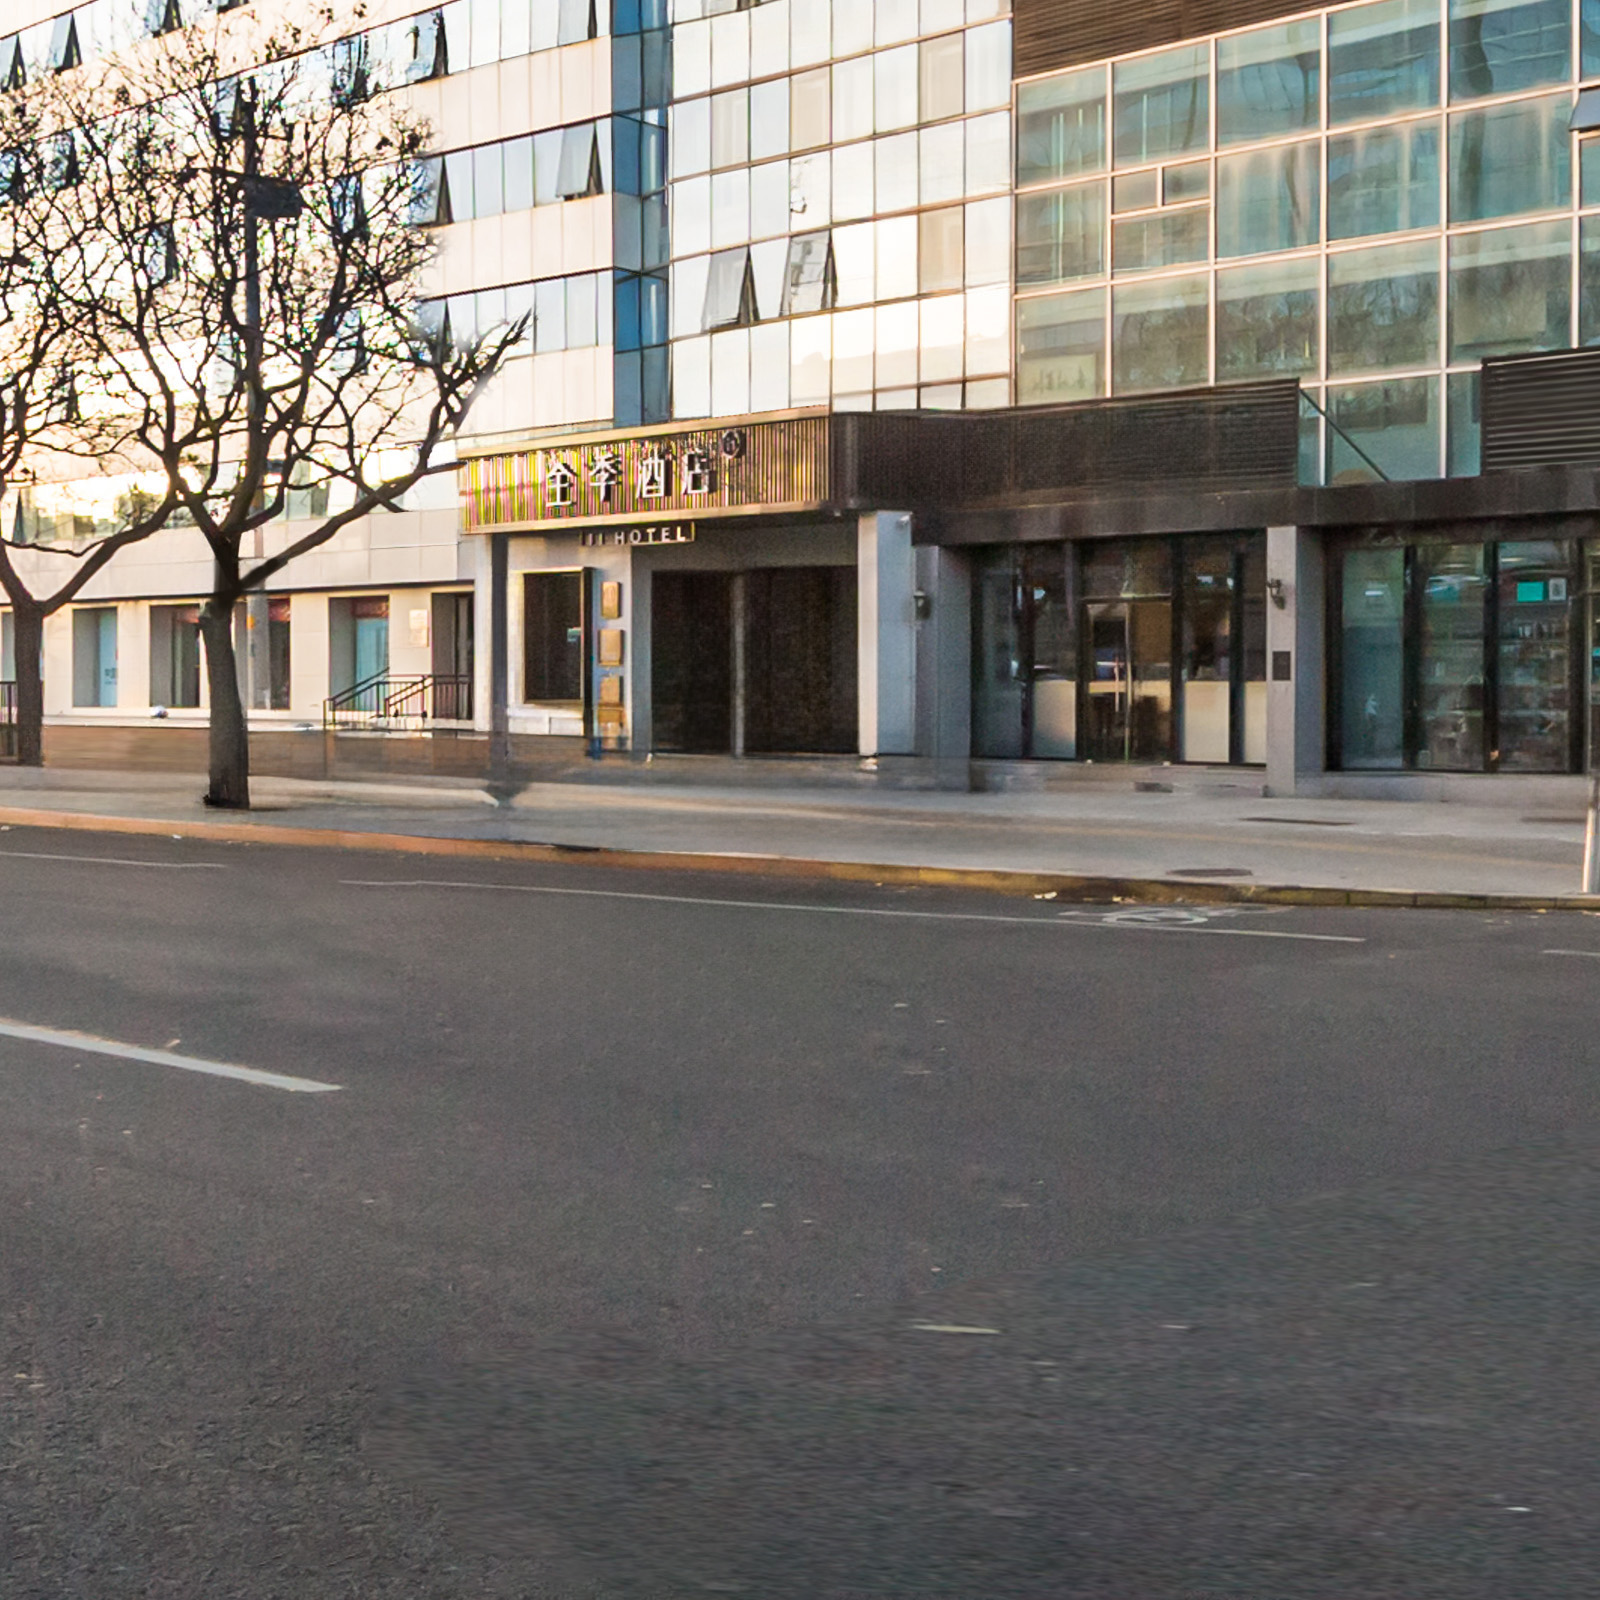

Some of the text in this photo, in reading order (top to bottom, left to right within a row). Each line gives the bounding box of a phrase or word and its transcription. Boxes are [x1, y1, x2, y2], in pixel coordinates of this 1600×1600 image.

[545, 447, 710, 507] 全季酒店
[614, 526, 686, 545] HOTEL
